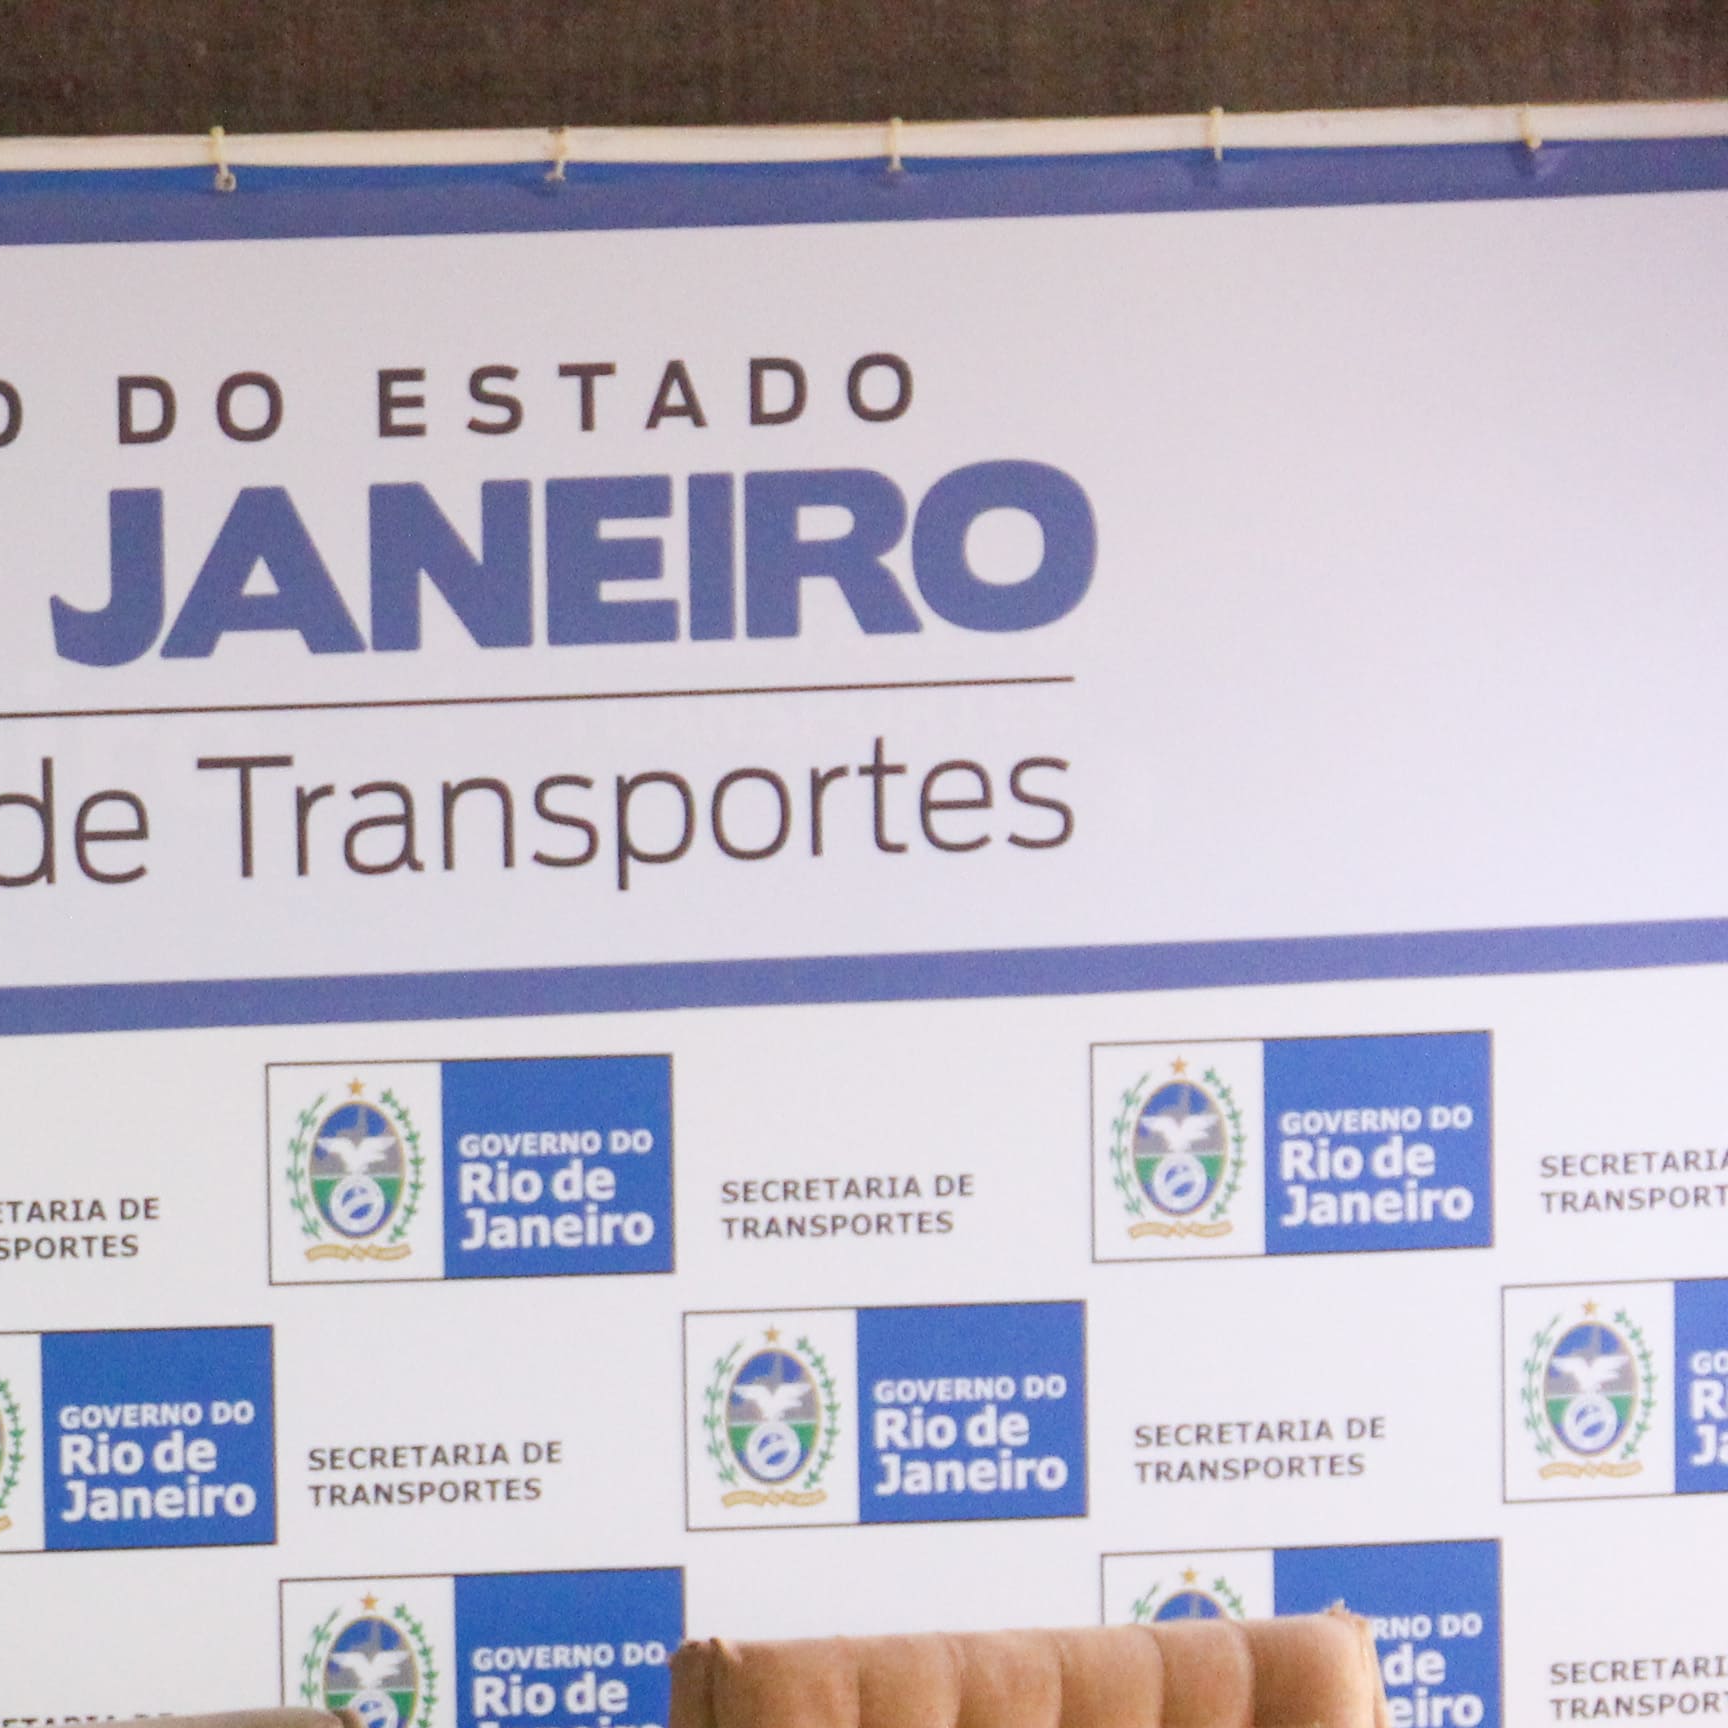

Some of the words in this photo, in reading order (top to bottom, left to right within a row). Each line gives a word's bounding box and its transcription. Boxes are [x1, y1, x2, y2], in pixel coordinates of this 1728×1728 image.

[117, 371, 285, 445] DO
[376, 352, 914, 438] ESTADO
[49, 459, 1097, 667] JANEIRO
[196, 736, 1075, 891] Transportes
[1280, 1106, 1422, 1136] GOVERNO
[1429, 1104, 1473, 1130] DO
[458, 1130, 602, 1158] GOVERNO
[609, 1129, 653, 1154] DO
[1280, 1137, 1364, 1181] Rio
[1371, 1134, 1436, 1179] de
[459, 1161, 543, 1204] Rio
[551, 1157, 616, 1202] de
[722, 1176, 921, 1204] SECRETARIA
[935, 1174, 972, 1197] DE
[120, 1198, 158, 1221] DE
[1281, 1179, 1474, 1227] Janeiro
[1540, 1184, 1728, 1213] TRANSPORT
[461, 1202, 654, 1250] Janeiro
[722, 1211, 953, 1239] TRANSPORTES
[874, 1376, 1016, 1404] GOVERNO
[1023, 1374, 1067, 1400] DO
[59, 1402, 203, 1430] GOVERNO
[210, 1400, 255, 1425] DO
[874, 1406, 957, 1450] Rio
[965, 1403, 1029, 1447] de
[1134, 1419, 1333, 1448] SECRETARIA
[1346, 1417, 1384, 1440] DE
[60, 1432, 144, 1476] Rio
[152, 1429, 217, 1473] de
[308, 1443, 509, 1471] SECRETARIA
[523, 1441, 561, 1464] DE
[1134, 1453, 1364, 1483] TRANSPORTES
[875, 1448, 1068, 1495] Janeiro
[61, 1474, 256, 1522] Janeiro
[308, 1478, 541, 1507] TRANSPORTES
[1438, 1612, 1483, 1638] DO
[472, 1643, 615, 1672] GOVERNO
[622, 1641, 666, 1666] DO
[1383, 1641, 1446, 1687] de
[1550, 1656, 1728, 1685] SECRETARI
[472, 1674, 556, 1717] Rio
[564, 1671, 628, 1714] de
[1549, 1691, 1728, 1720] TRANSPOR
